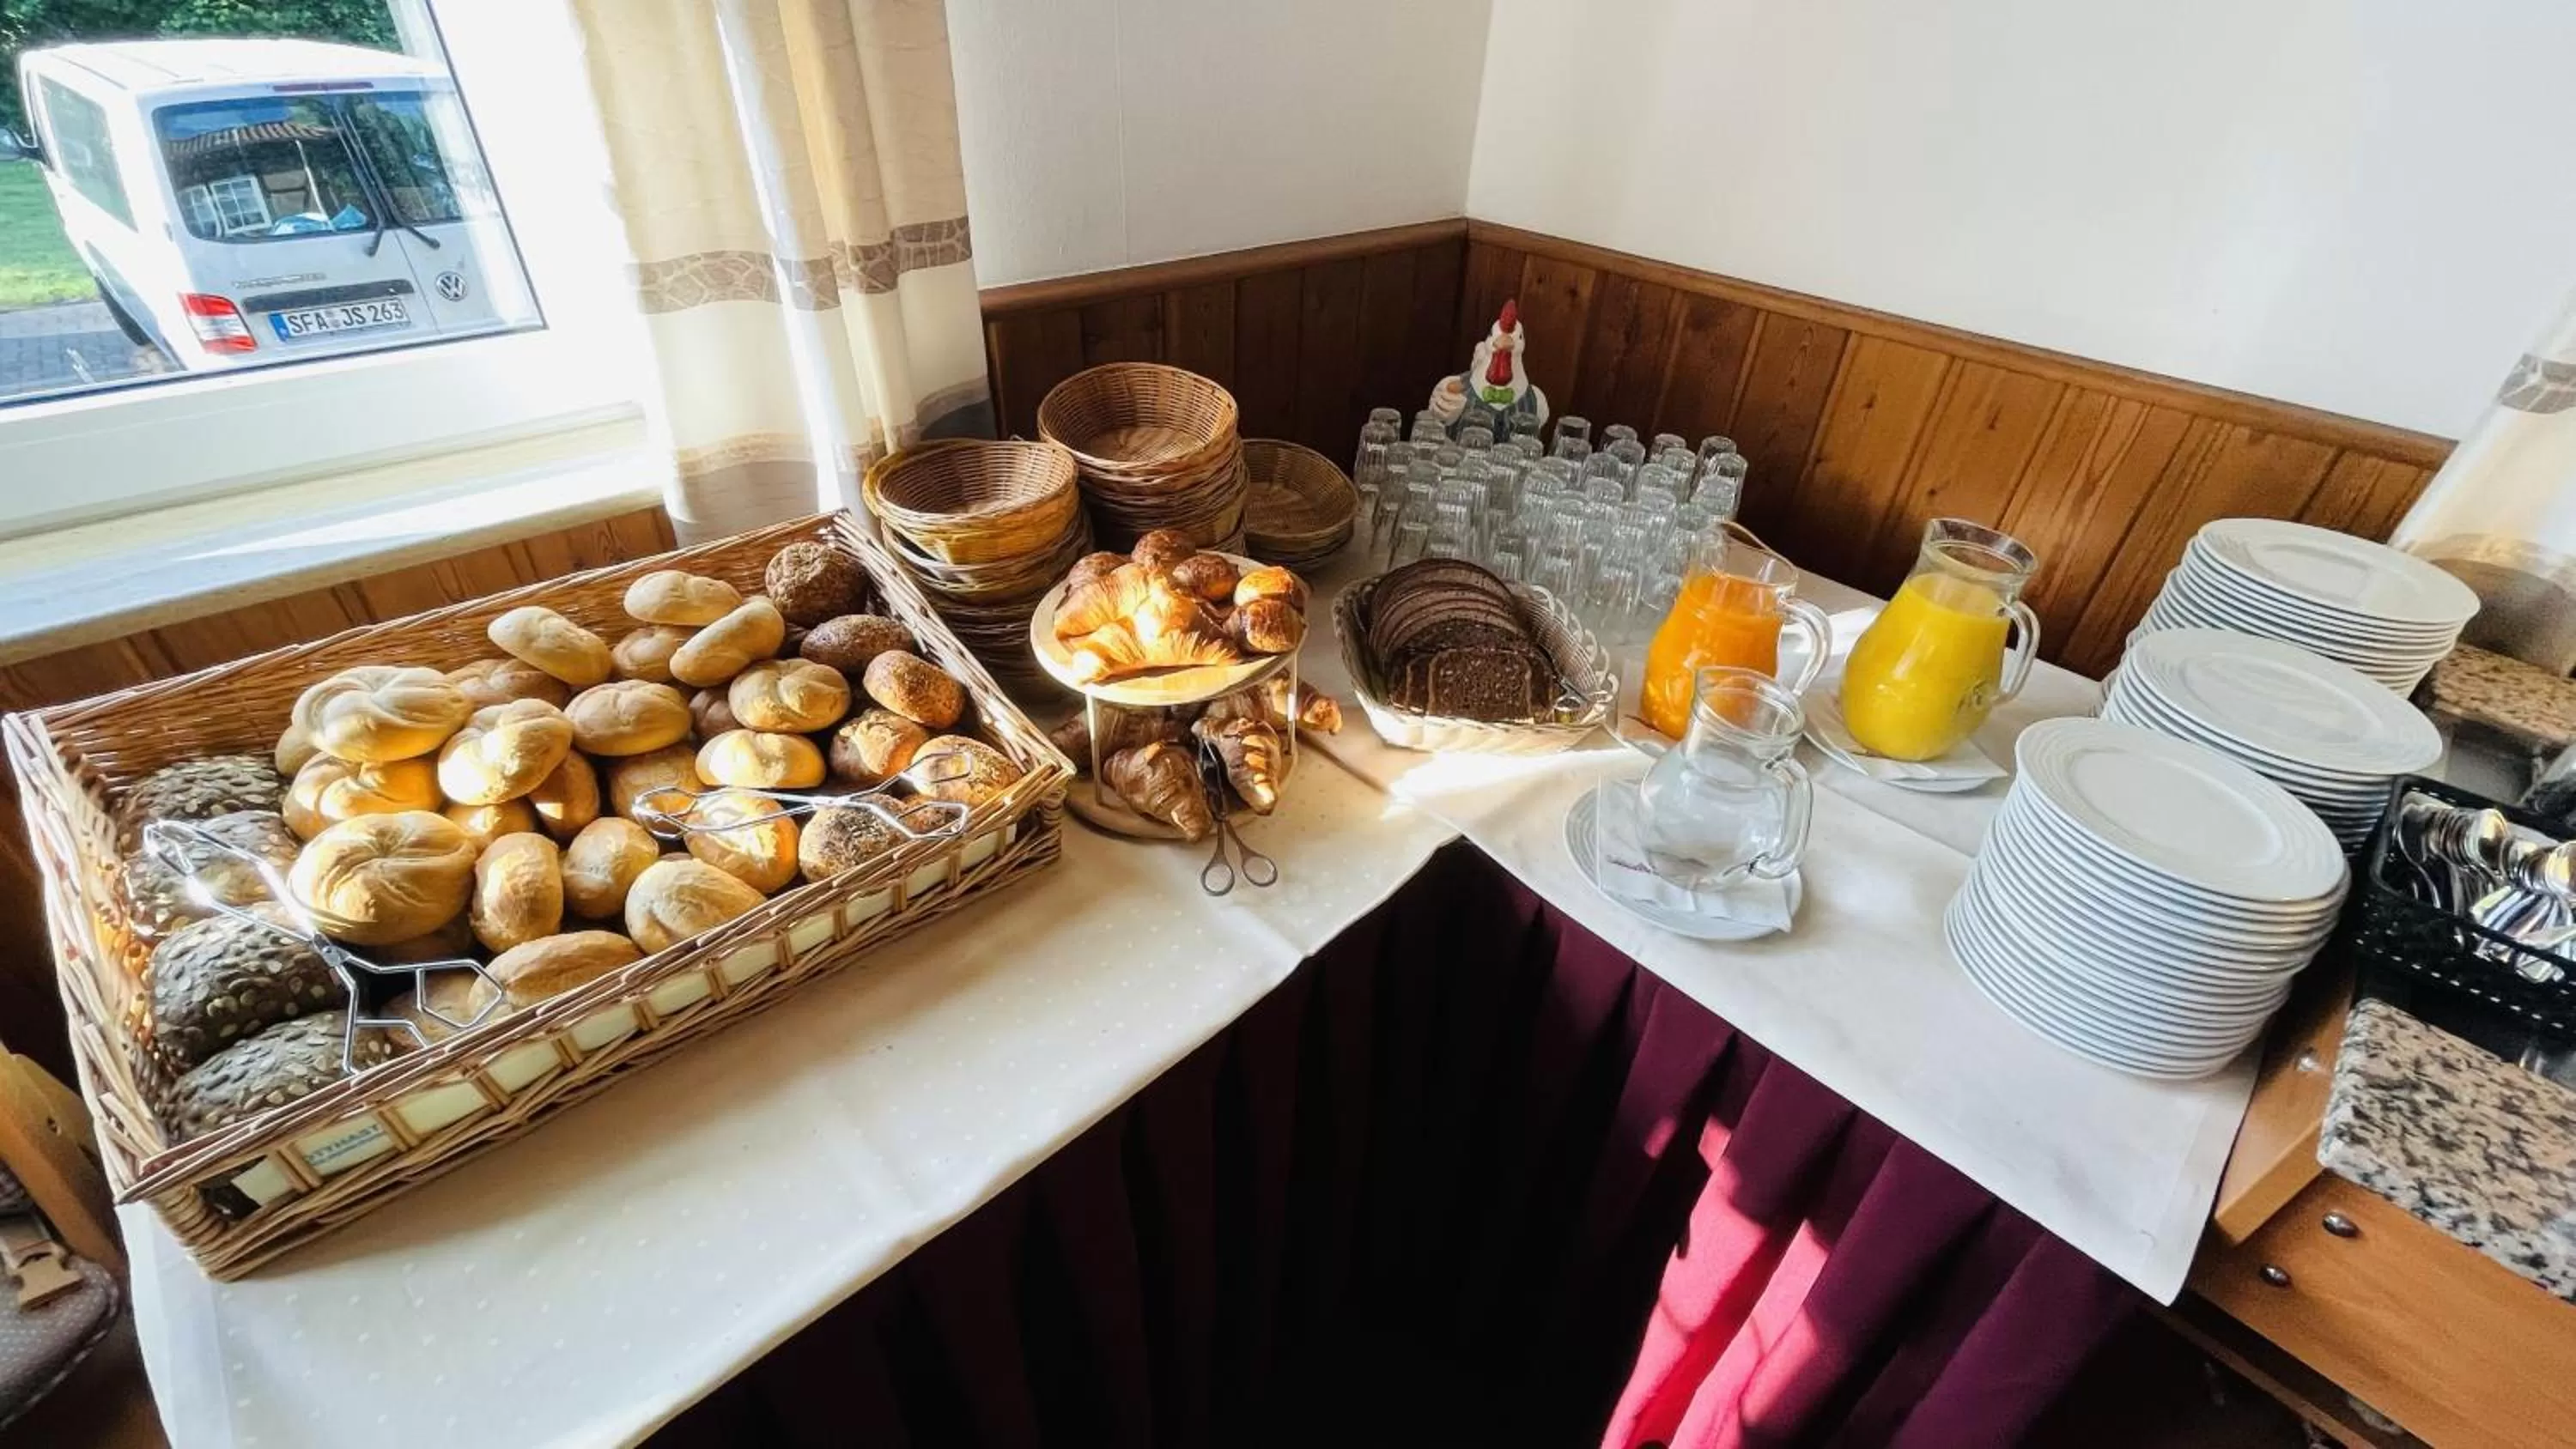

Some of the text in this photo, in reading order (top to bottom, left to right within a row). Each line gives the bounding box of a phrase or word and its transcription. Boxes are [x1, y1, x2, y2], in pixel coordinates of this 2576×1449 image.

[288, 301, 404, 333] SFA JS 263
